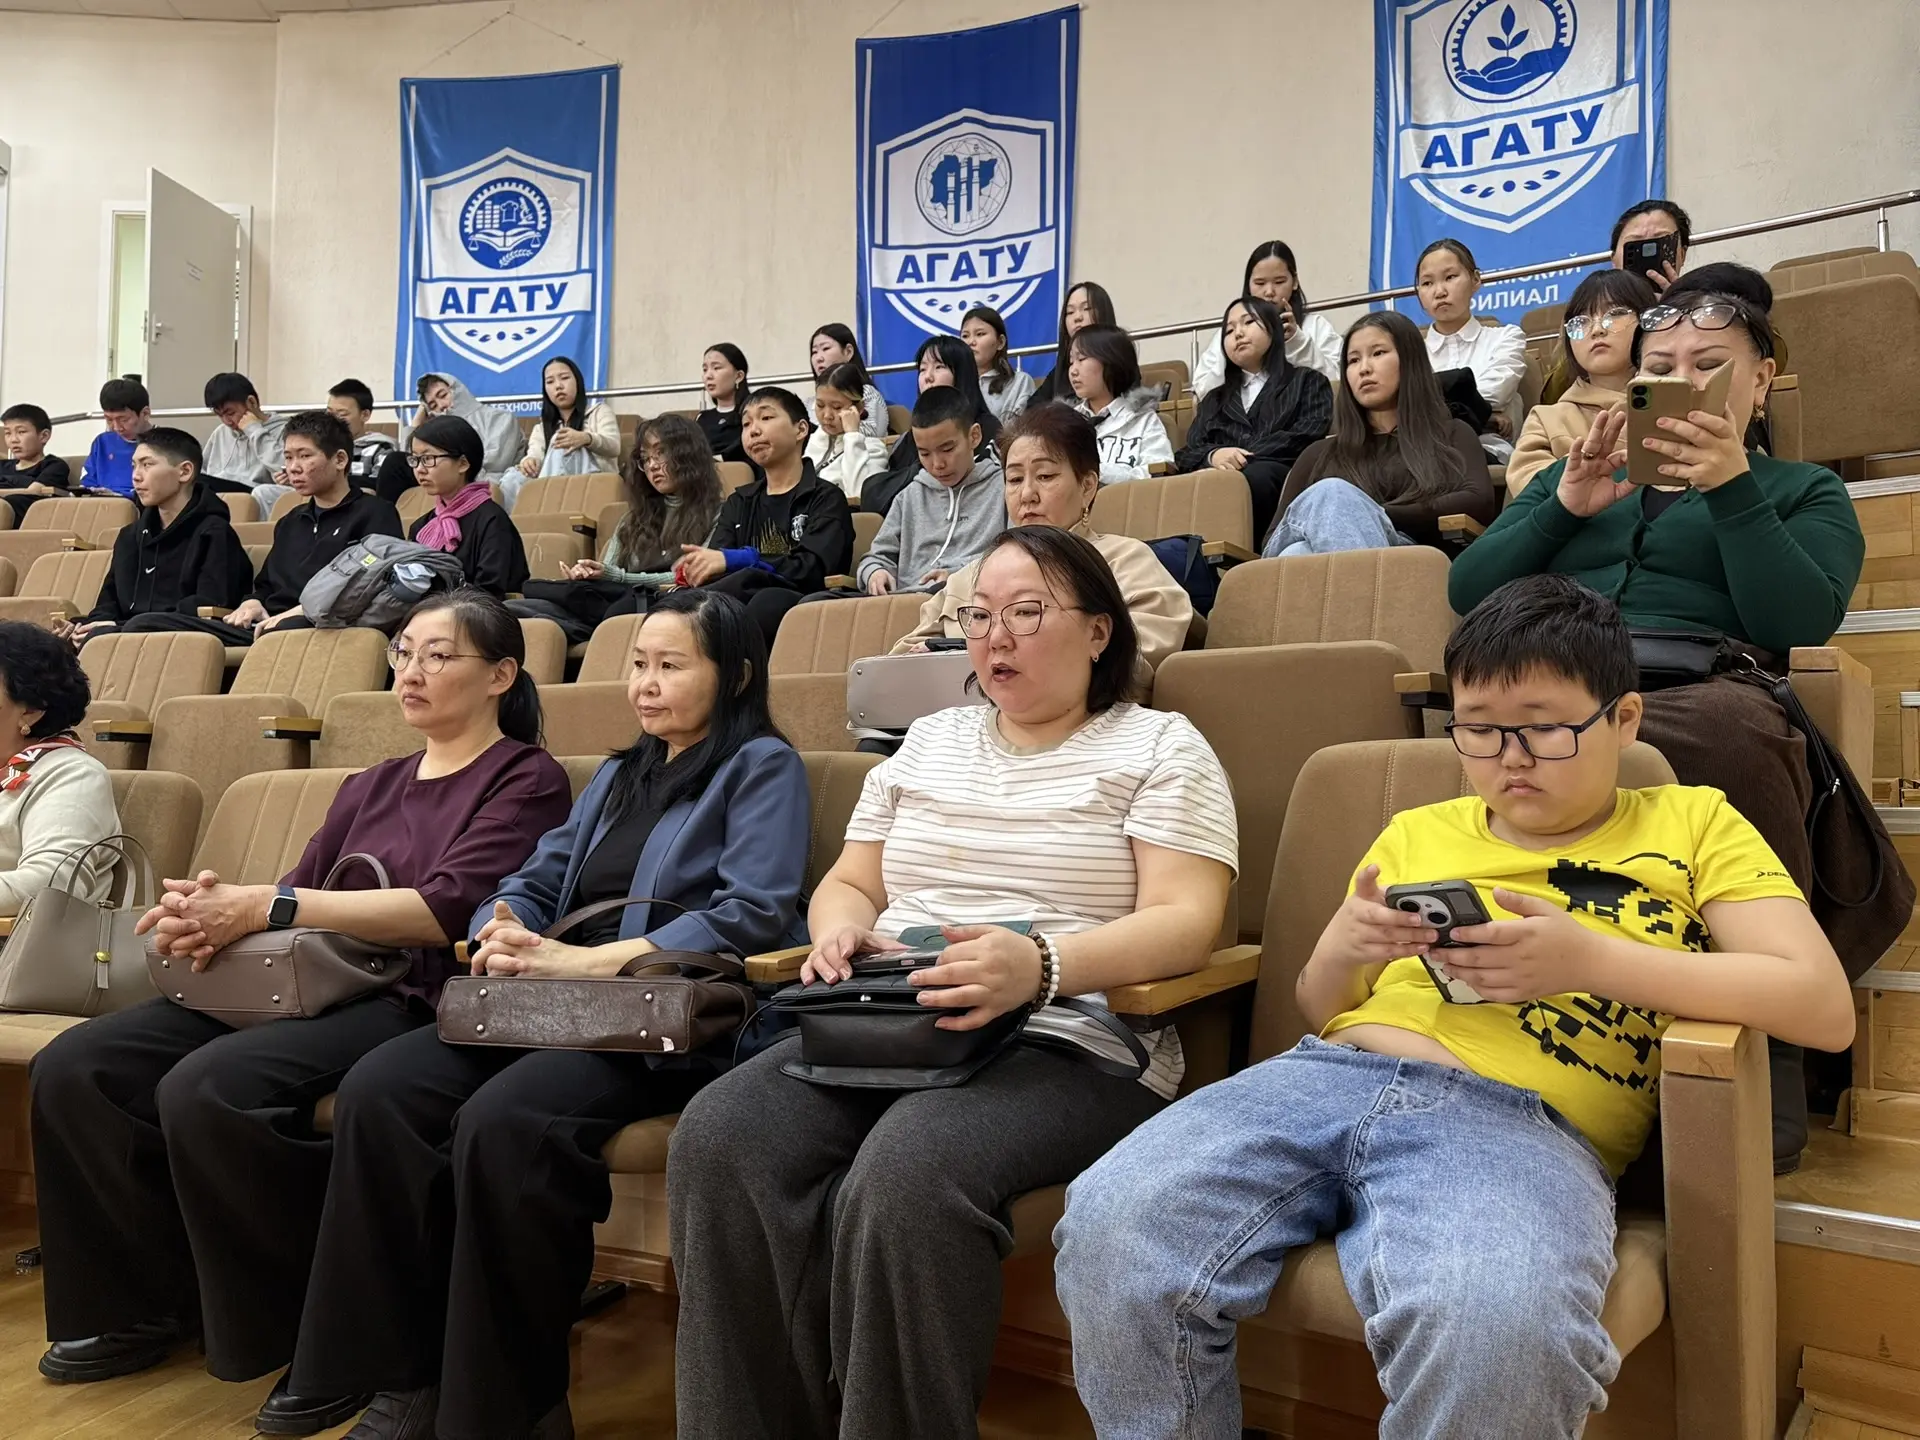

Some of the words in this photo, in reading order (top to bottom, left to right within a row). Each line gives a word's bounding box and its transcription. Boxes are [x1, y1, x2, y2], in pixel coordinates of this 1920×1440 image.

[1421, 103, 1605, 169] АГАТУ
[896, 240, 1031, 284] АГАТУ
[439, 281, 568, 315] АГАТУ
